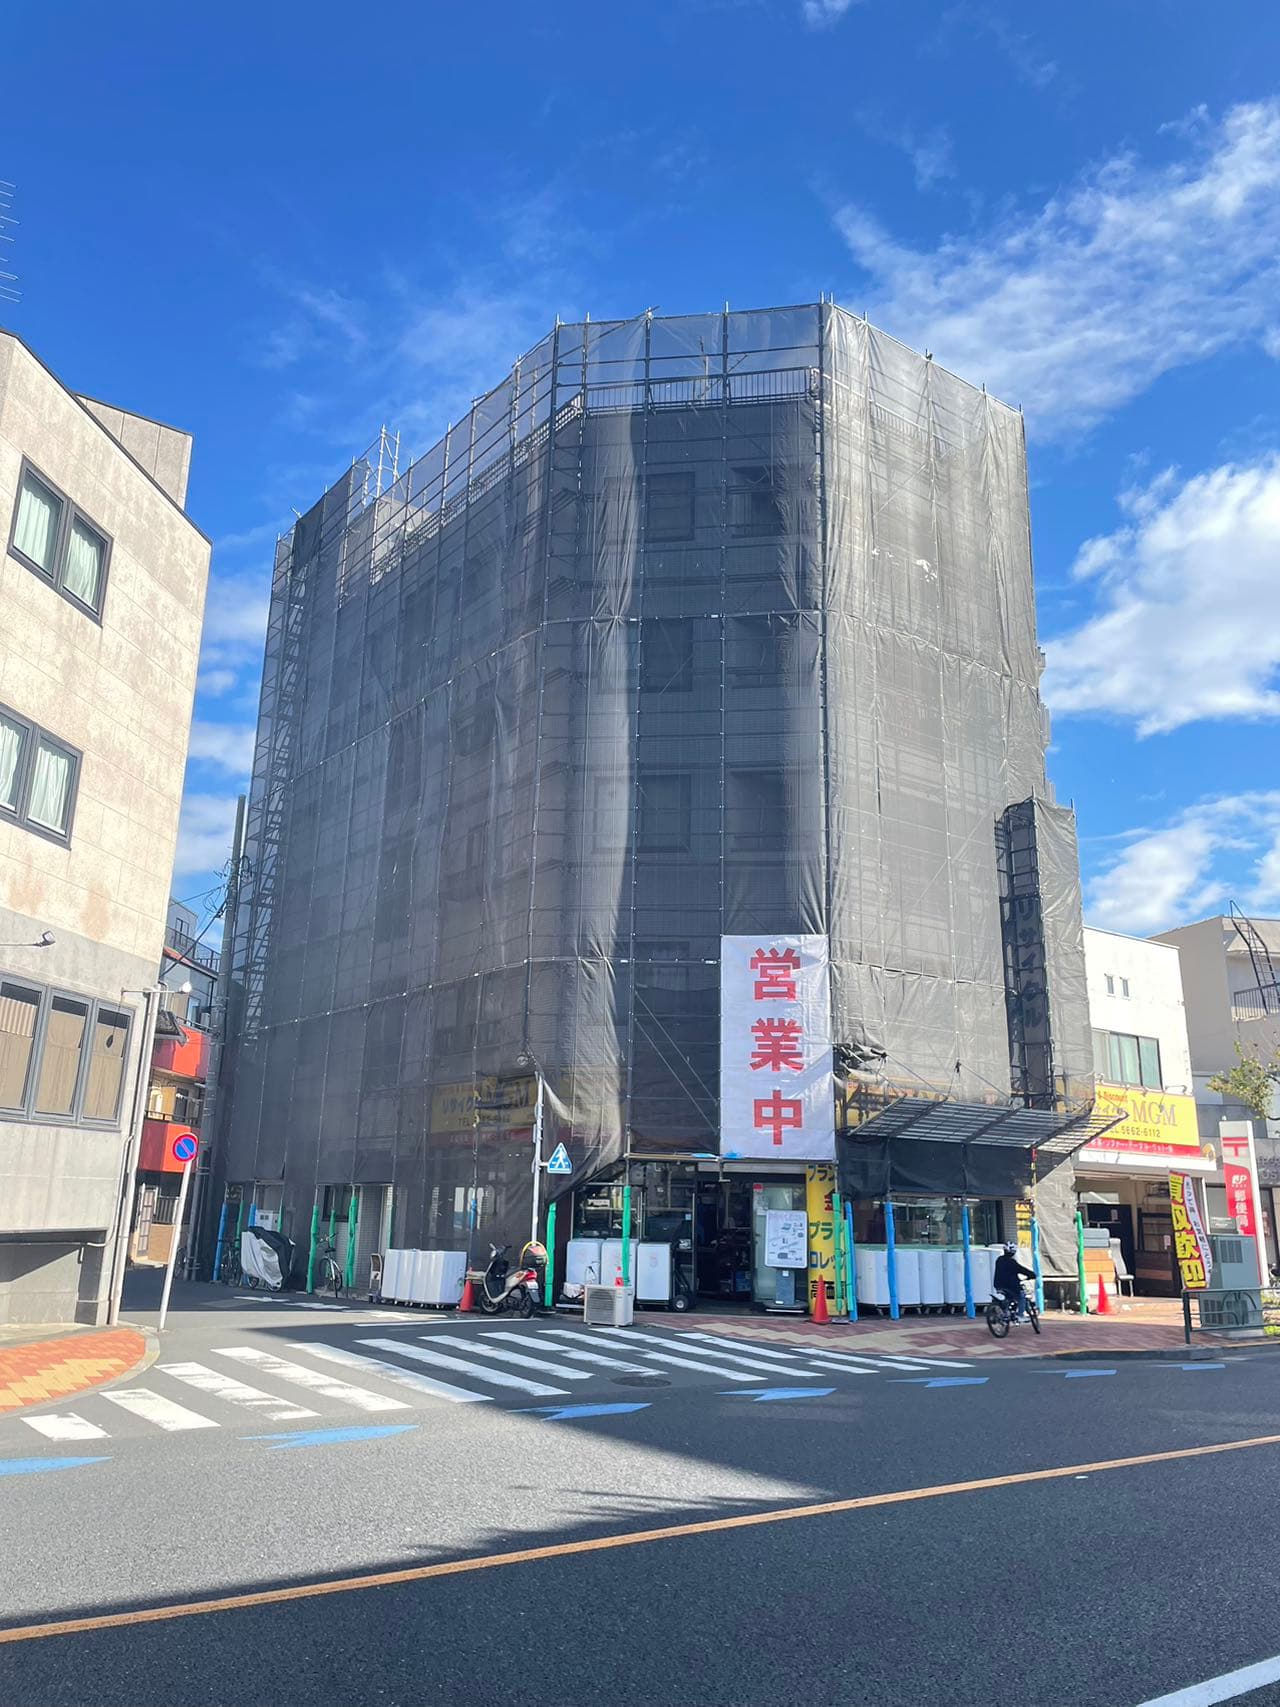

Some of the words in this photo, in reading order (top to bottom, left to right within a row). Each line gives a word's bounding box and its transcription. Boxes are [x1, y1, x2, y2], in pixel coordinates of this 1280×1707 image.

[749, 946, 804, 1146] 営業中
[1131, 1100, 1177, 1126] MGM
[1234, 1189, 1249, 1227] 郵便局
[809, 1221, 836, 1241] プラ
